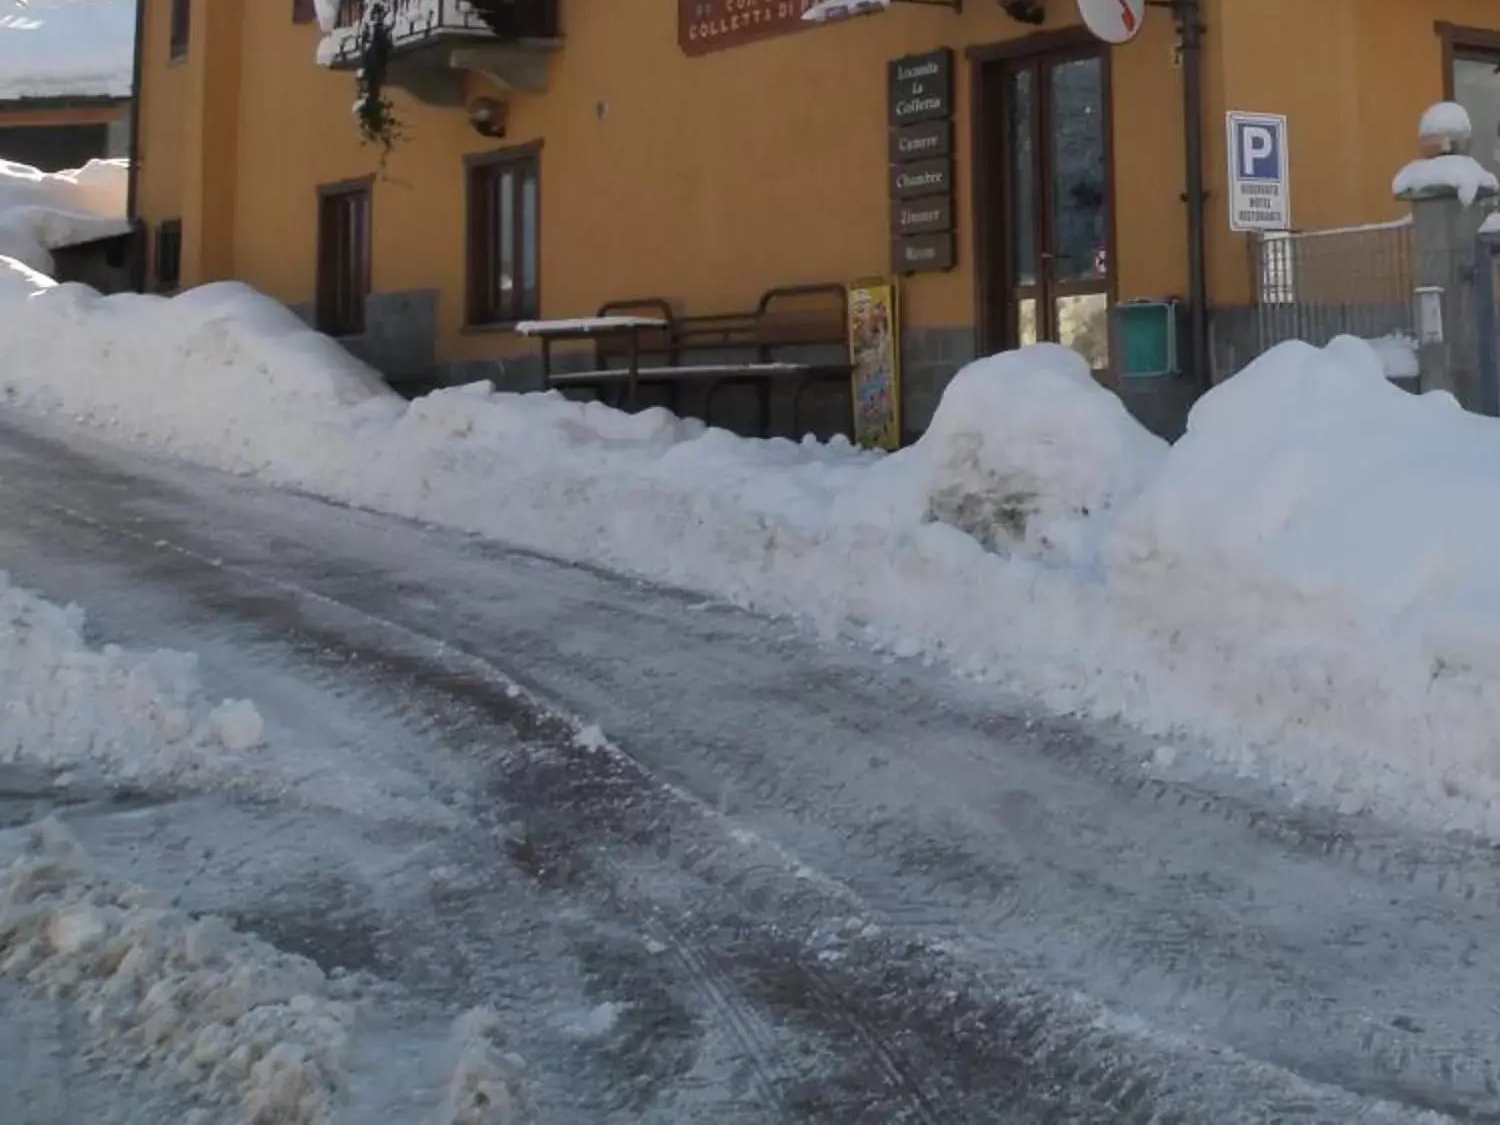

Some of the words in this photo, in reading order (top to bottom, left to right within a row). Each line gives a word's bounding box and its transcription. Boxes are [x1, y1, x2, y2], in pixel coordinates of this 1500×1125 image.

[689, 8, 771, 41] COLLETTA
[778, 2, 794, 20] DI
[1243, 126, 1273, 175] P
